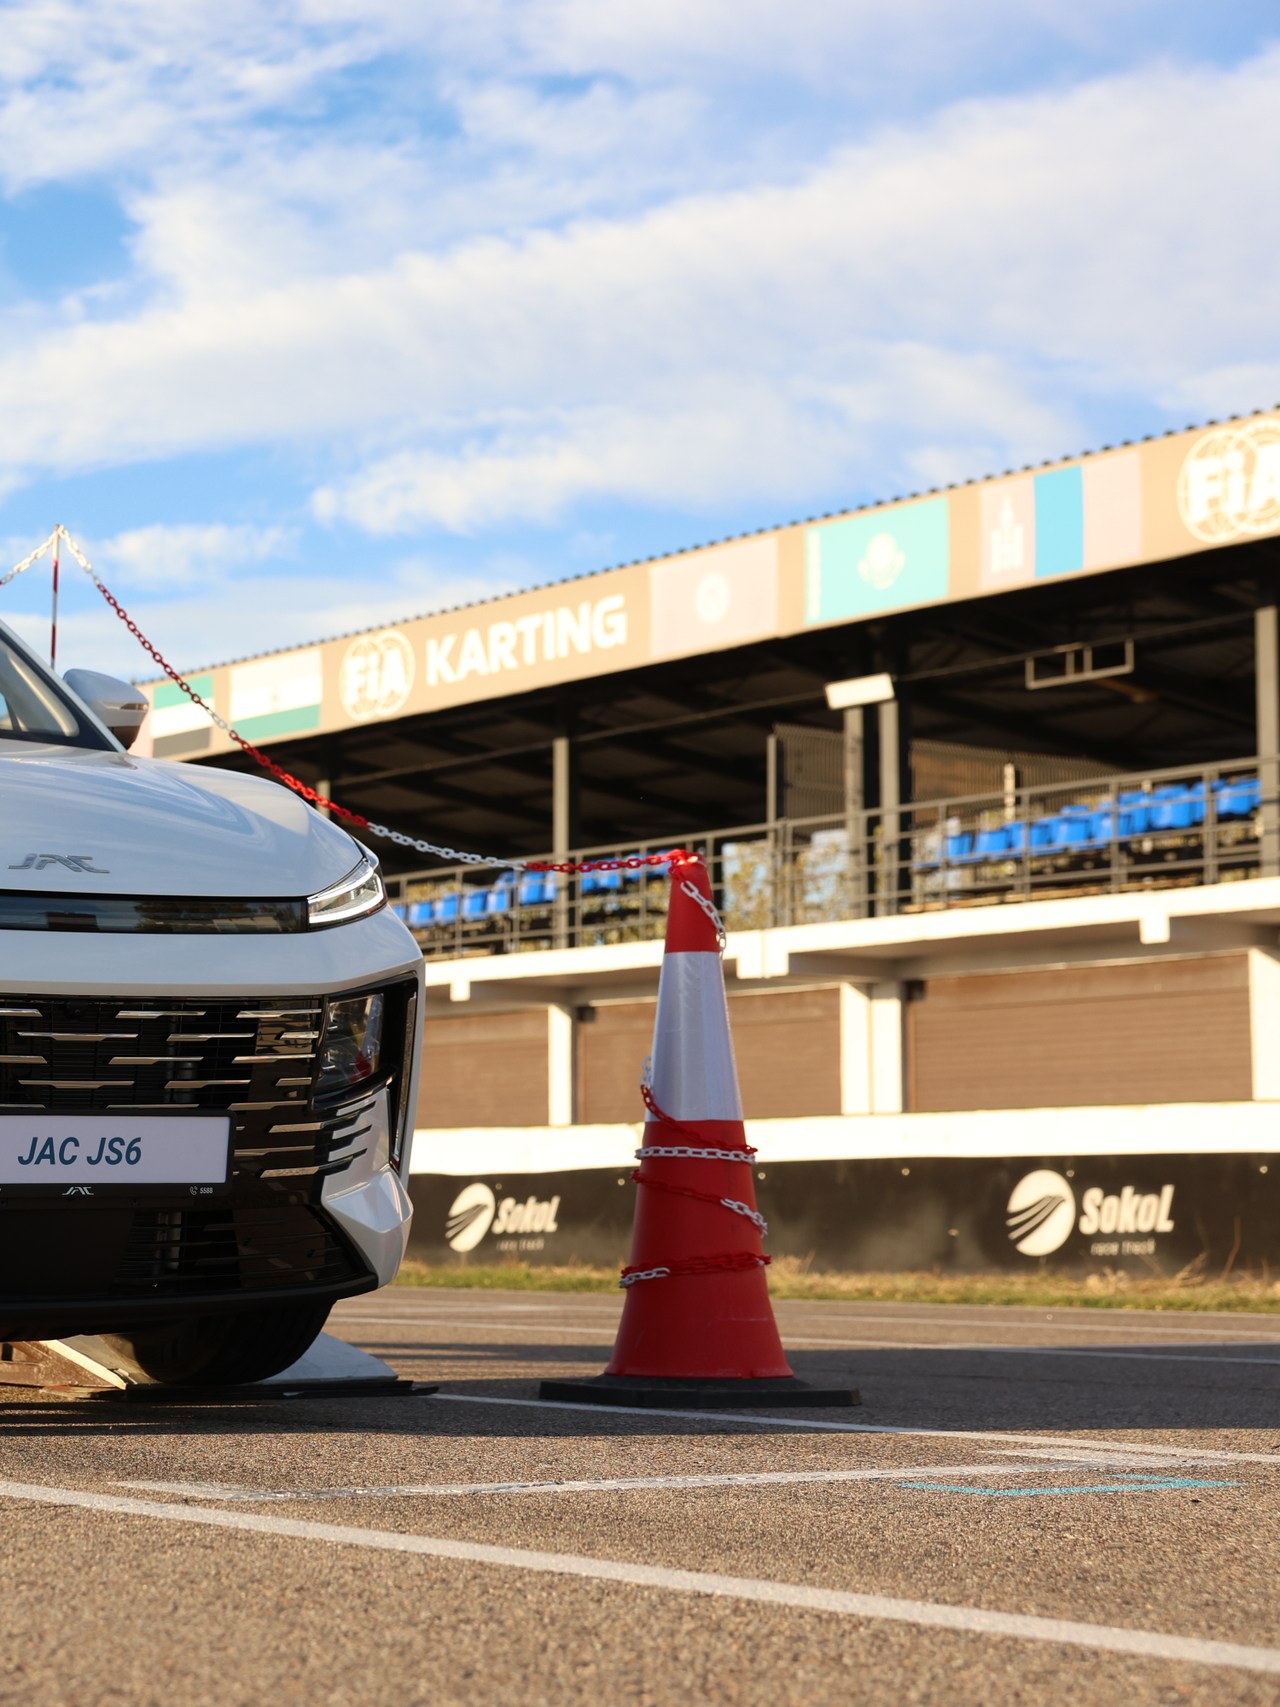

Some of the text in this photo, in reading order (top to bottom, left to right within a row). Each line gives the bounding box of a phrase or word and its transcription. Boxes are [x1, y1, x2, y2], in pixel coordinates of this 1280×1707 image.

[426, 594, 628, 687] KARTING
[17, 1136, 142, 1166] JAC JS6
